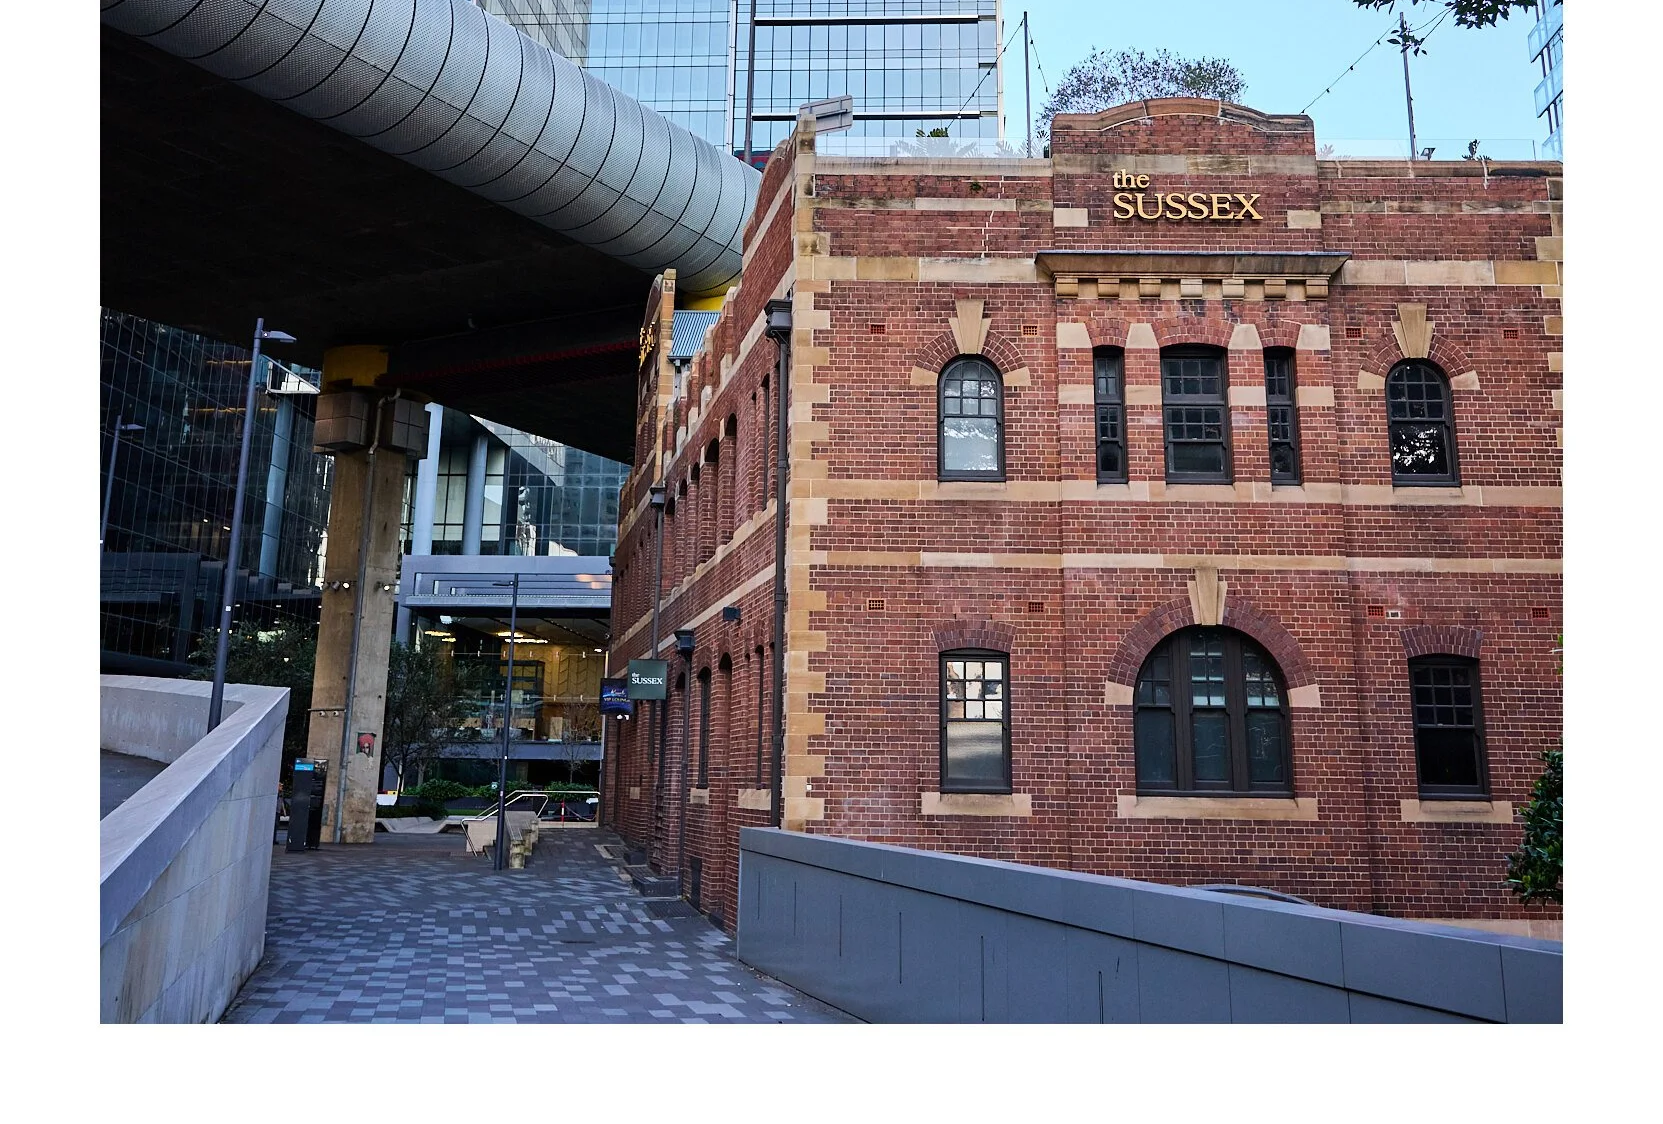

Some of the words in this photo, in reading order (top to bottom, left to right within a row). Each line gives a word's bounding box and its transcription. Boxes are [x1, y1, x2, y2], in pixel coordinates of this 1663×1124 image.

[1113, 169, 1150, 189] the
[1113, 193, 1264, 220] SUSSEX
[632, 677, 663, 685] SUSSEX
